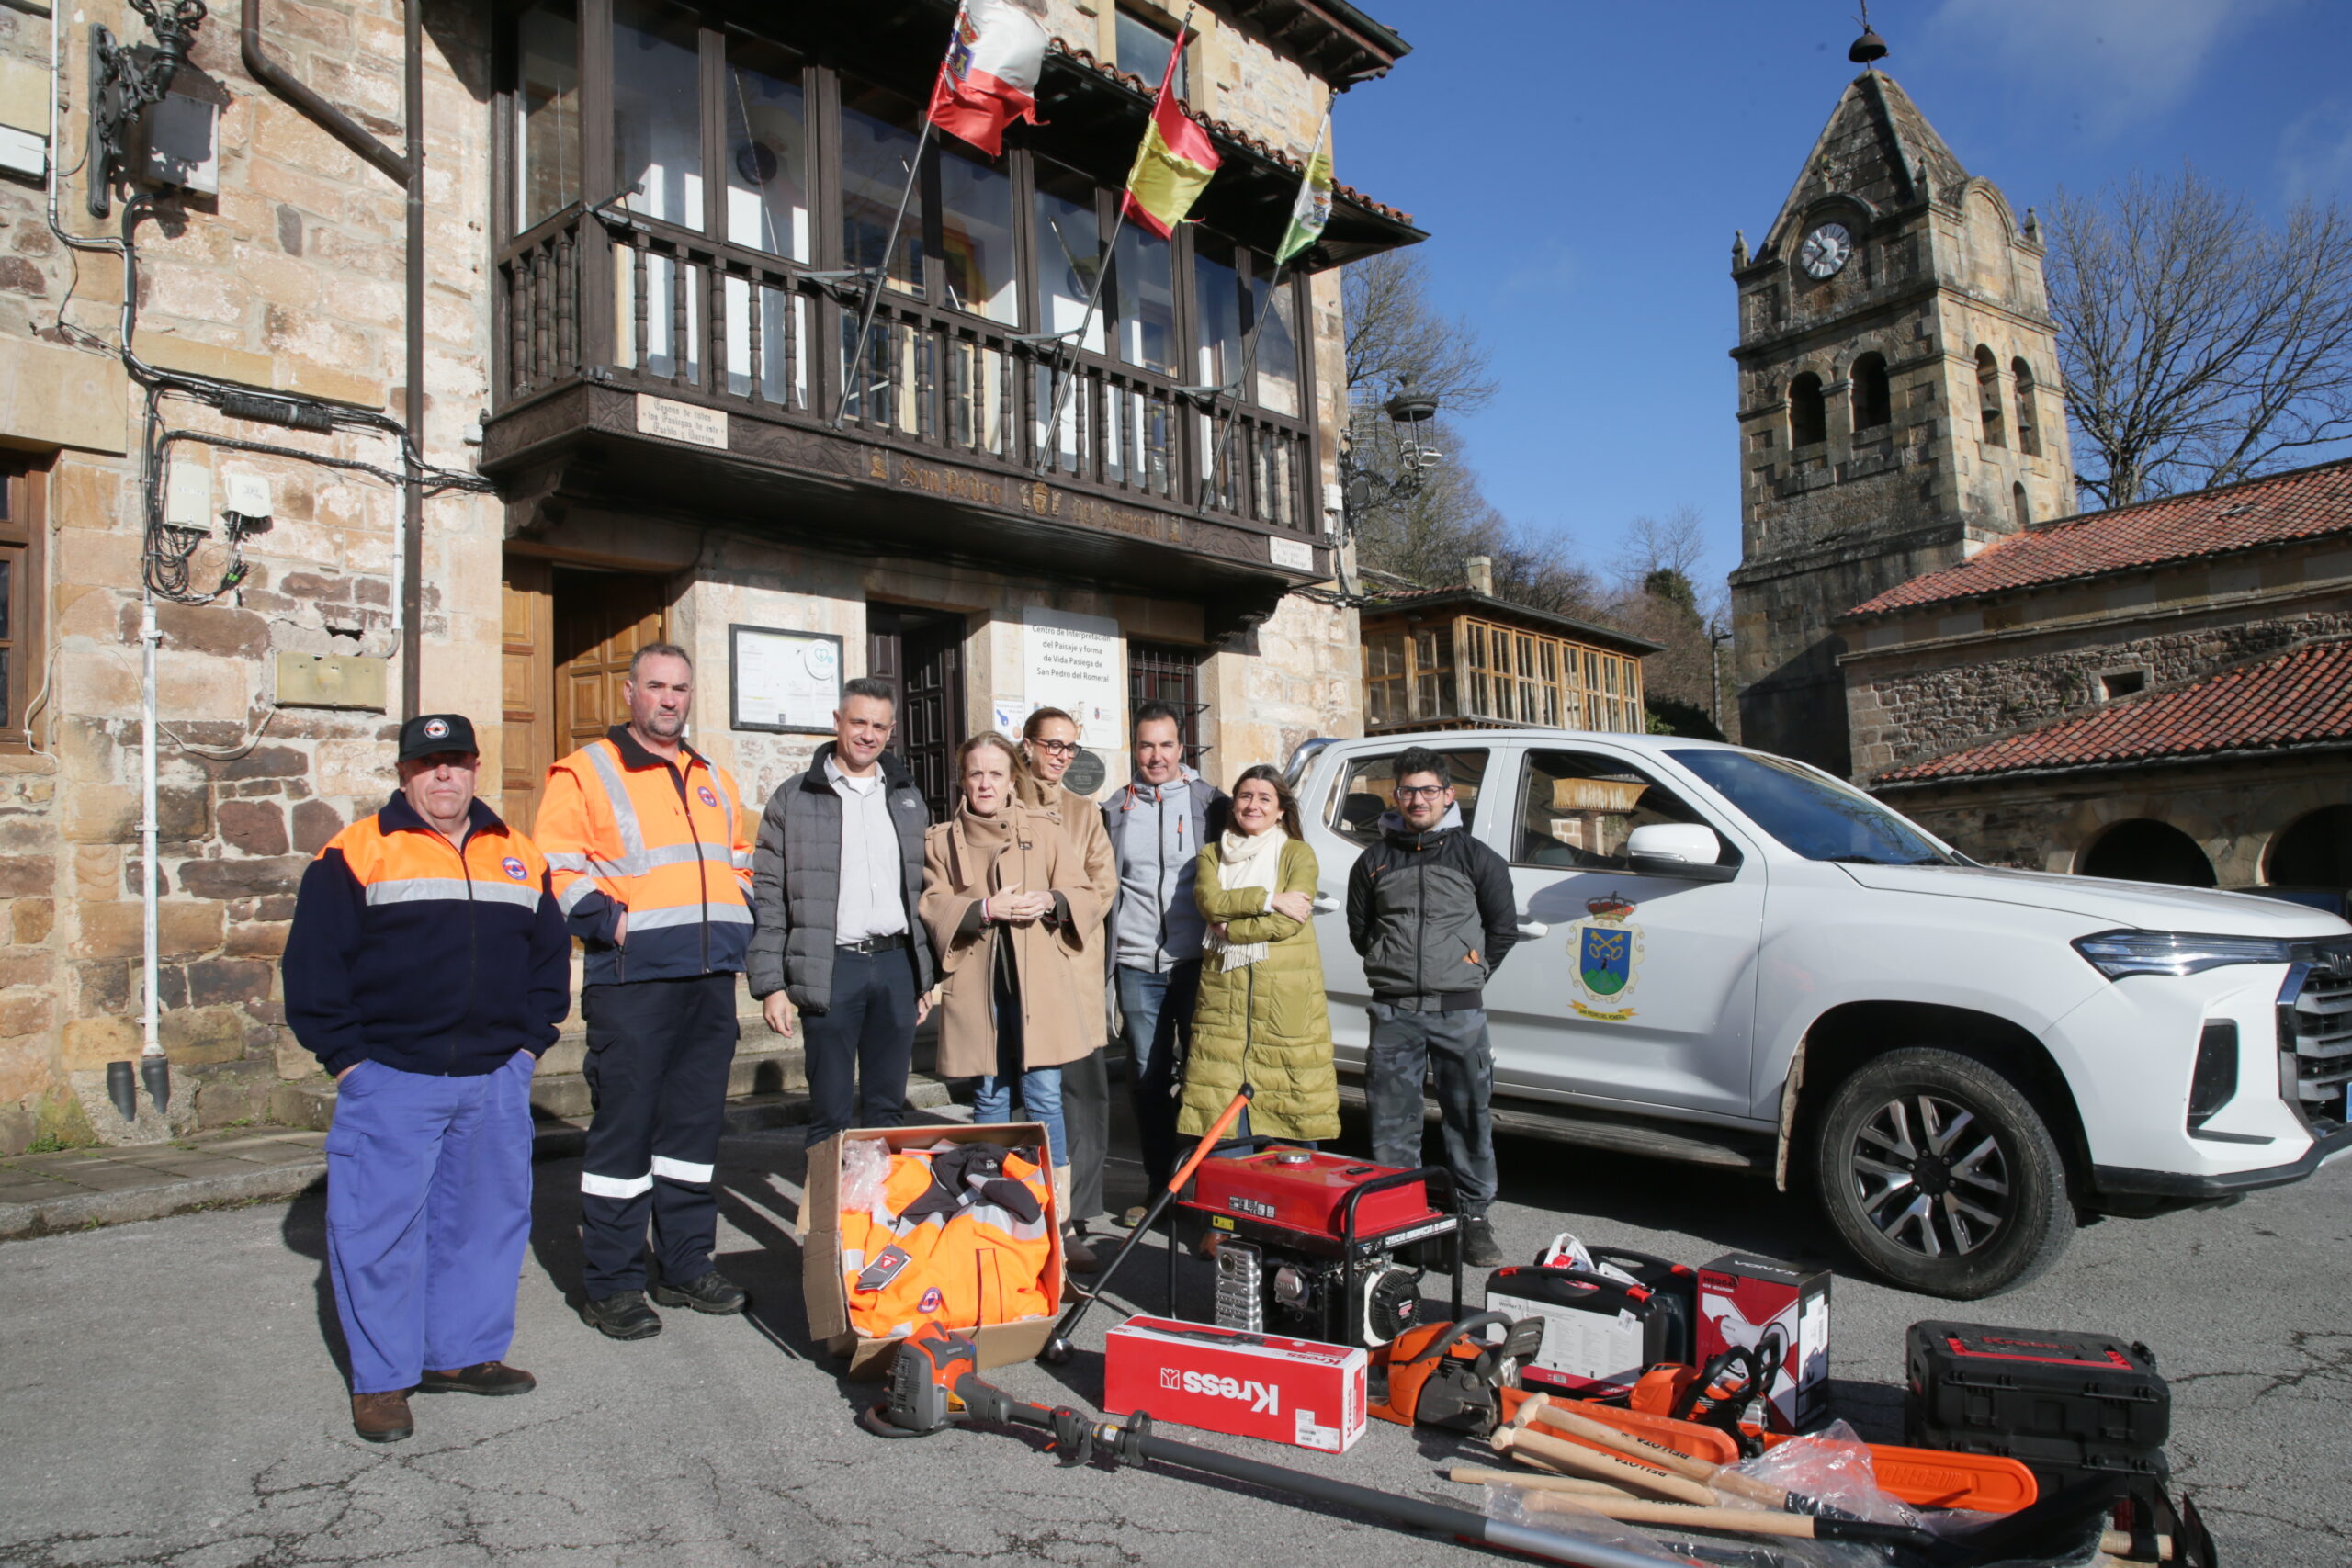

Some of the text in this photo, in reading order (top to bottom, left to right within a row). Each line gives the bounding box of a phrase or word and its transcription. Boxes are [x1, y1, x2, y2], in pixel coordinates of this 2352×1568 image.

[900, 457, 1001, 505] San Pedro
[1101, 504, 1161, 540] Romeral
[1032, 625, 1056, 636] Centro
[1042, 640, 1054, 649] del
[1054, 641, 1078, 653] Paisaje
[1083, 645, 1102, 655] forma
[1043, 654, 1102, 669] de Vida Pasiega de
[1036, 667, 1110, 682] San Pedro del Romeral
[1734, 1260, 1801, 1277] VONYX
[1498, 1301, 1518, 1310] Worker
[1286, 1352, 1342, 1366] Kress
[1183, 1370, 1279, 1416] Kress
[1614, 1457, 1668, 1478] BELLOTA
